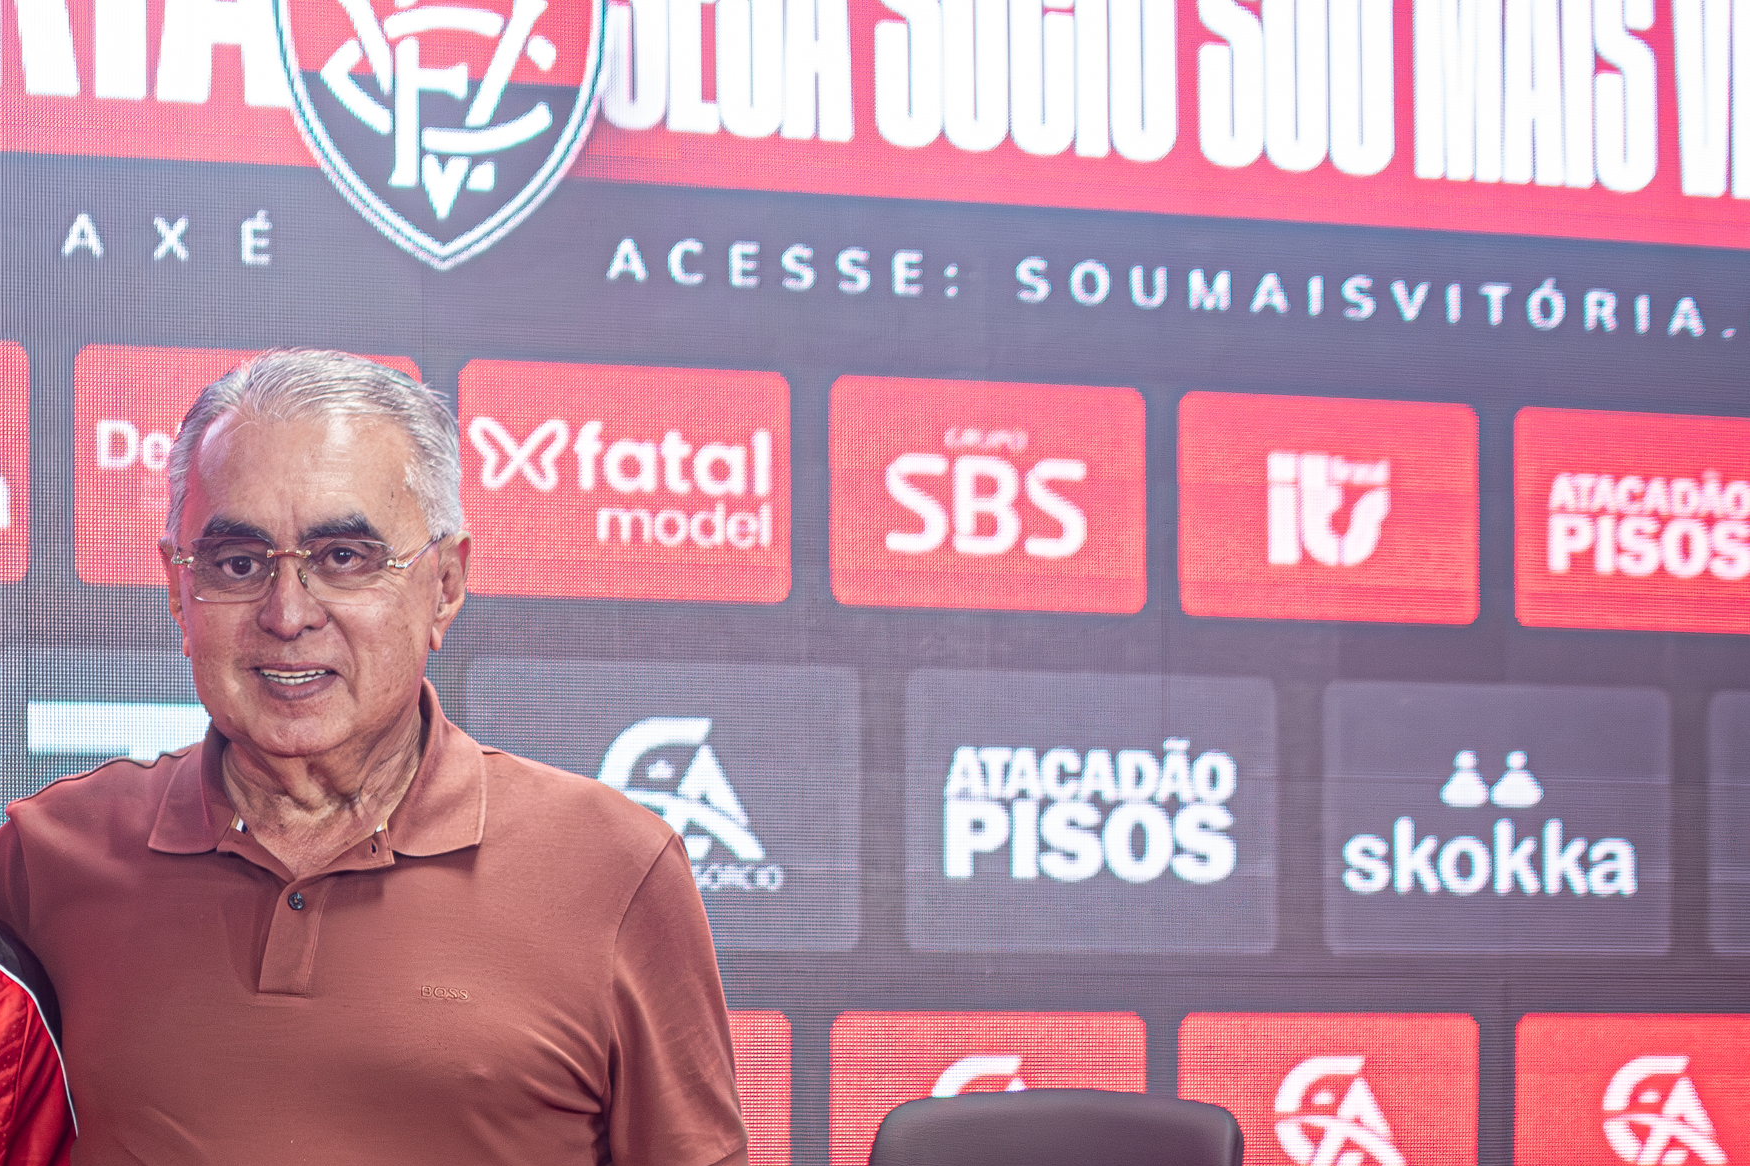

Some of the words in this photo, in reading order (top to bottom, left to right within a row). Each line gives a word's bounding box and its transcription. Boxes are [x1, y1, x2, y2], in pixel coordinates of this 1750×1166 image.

[61, 209, 273, 267] AXÉ
[606, 237, 960, 299] ACESSE:
[573, 419, 772, 497] fatal
[596, 502, 772, 549] model
[885, 452, 1087, 558] SBS
[1546, 513, 1750, 582] PISOS
[944, 737, 1238, 803] ATACADÃO
[944, 800, 1238, 883] PISOS
[1341, 815, 1639, 897] skokka
[420, 985, 470, 1001] BOSS
